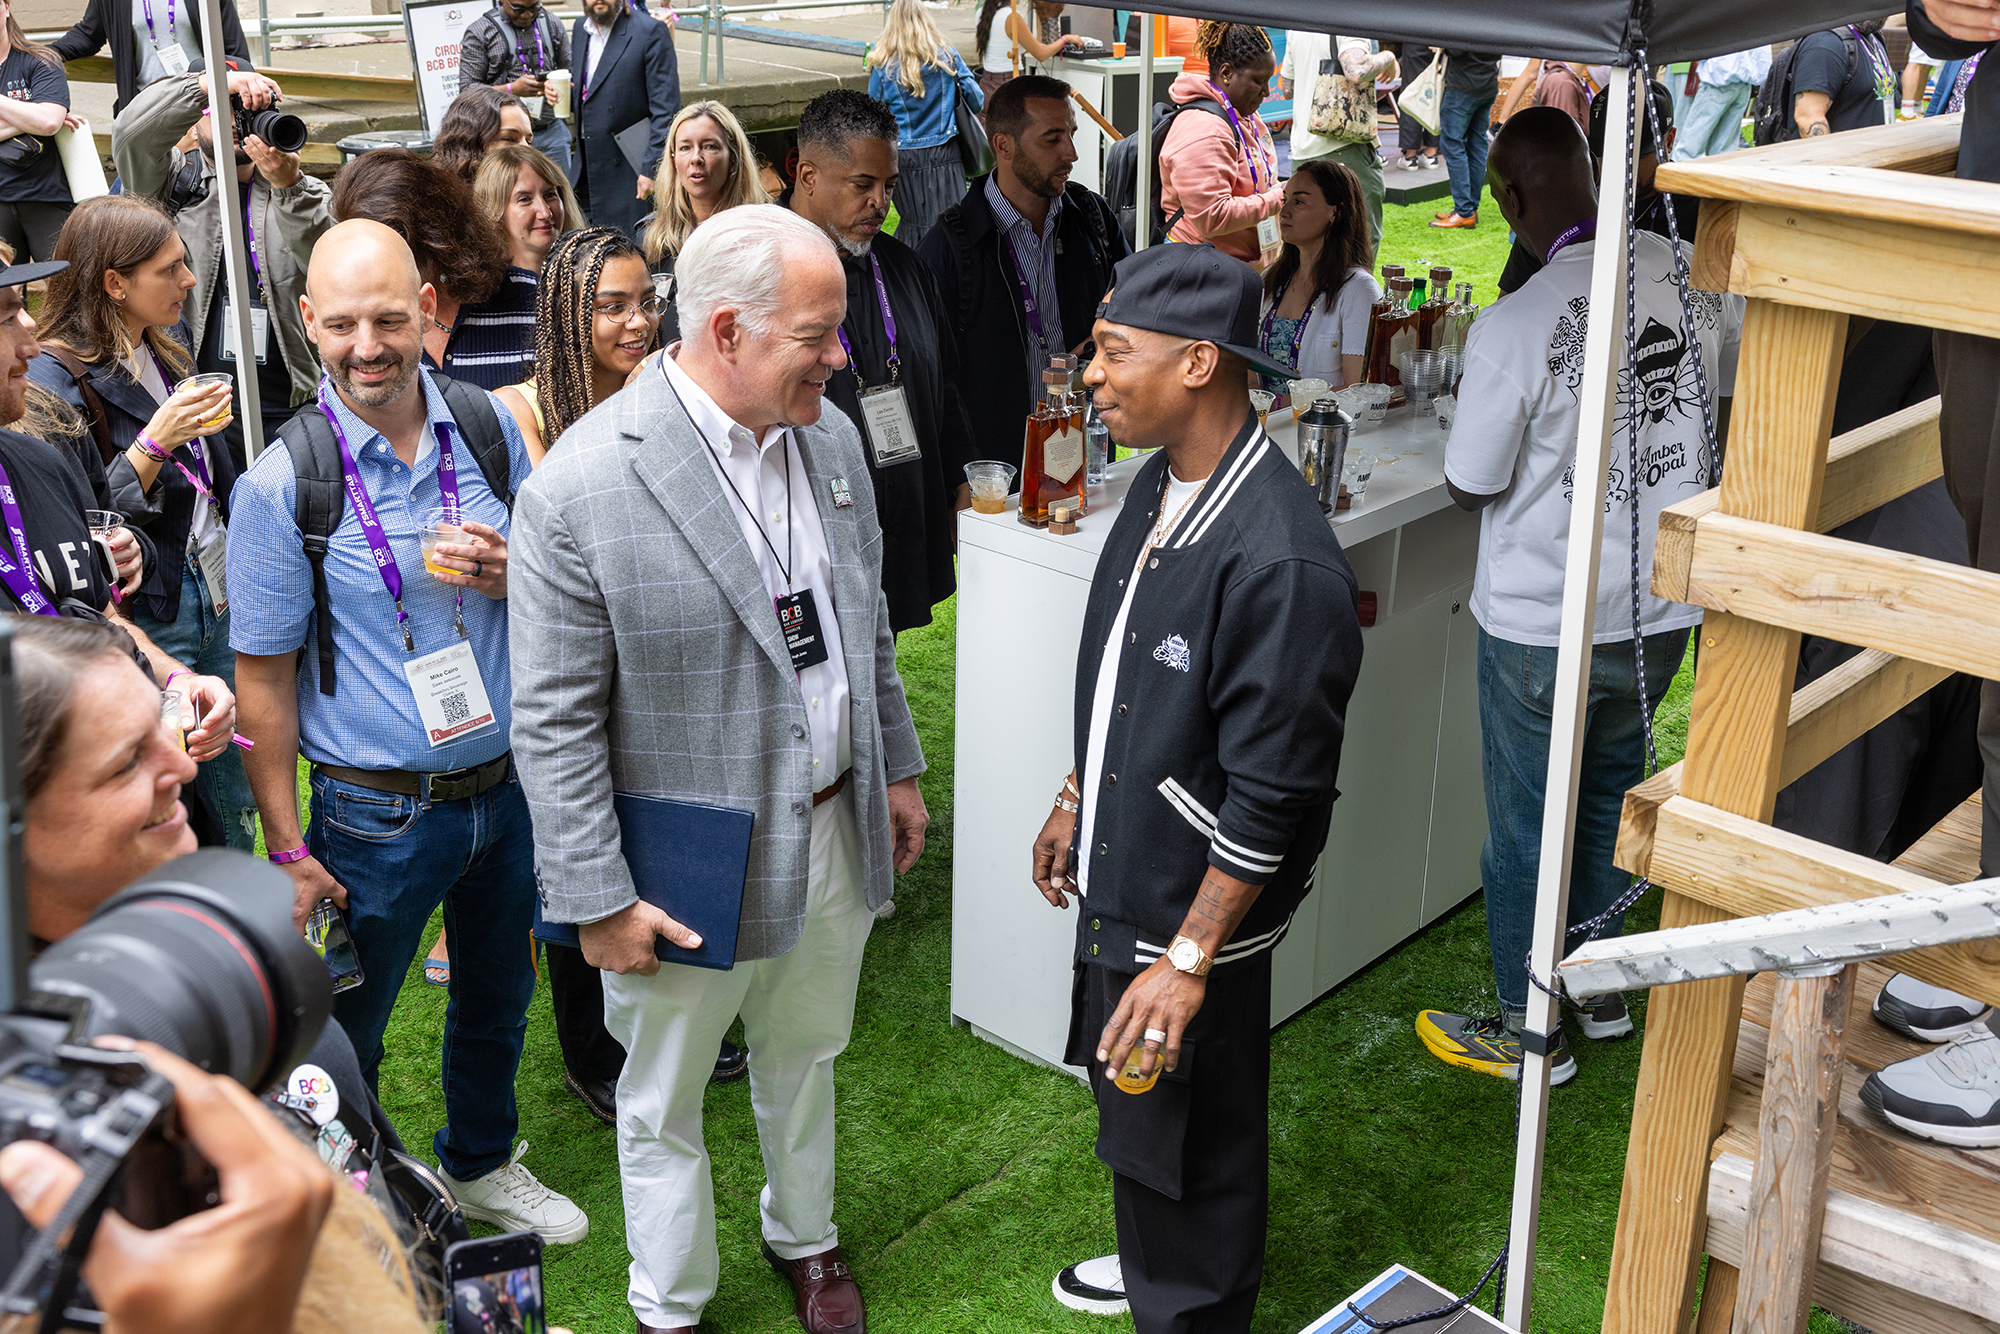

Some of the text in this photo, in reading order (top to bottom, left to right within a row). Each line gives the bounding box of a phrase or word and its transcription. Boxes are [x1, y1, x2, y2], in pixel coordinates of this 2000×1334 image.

[444, 10, 463, 21] BCB
[426, 57, 462, 71] BCB BR
[444, 453, 454, 471] BCB
[1637, 442, 1686, 475] Amber
[1638, 453, 1687, 487] & Opal
[4, 485, 16, 505] BCB
[345, 474, 369, 520] SMARTTAB
[373, 548, 386, 567] BCB
[20, 593, 40, 614] BCB
[781, 604, 803, 622] BCB
[443, 667, 458, 676] Cairo
[434, 731, 441, 740] A
[298, 1078, 331, 1095] BCB
